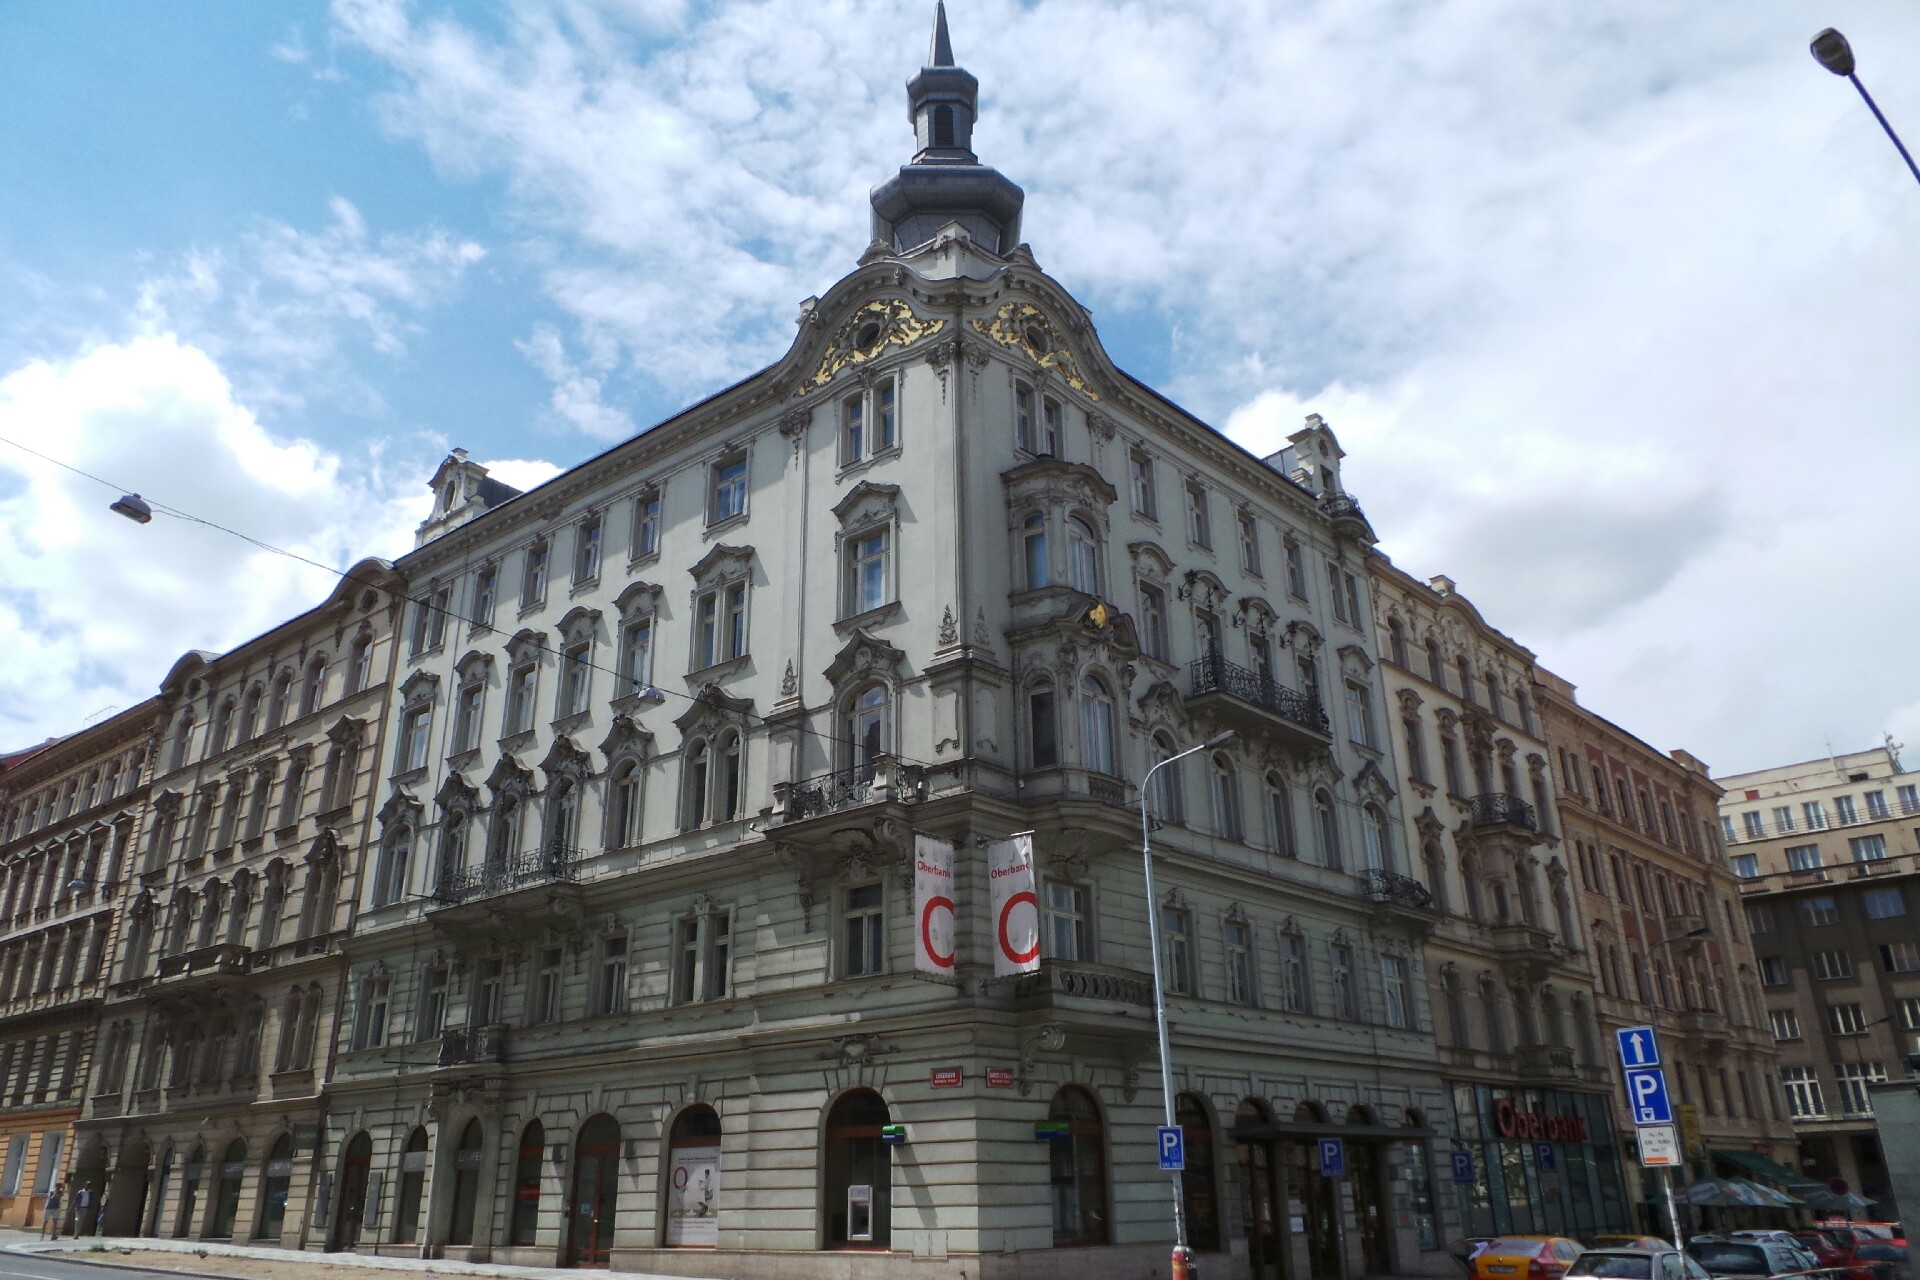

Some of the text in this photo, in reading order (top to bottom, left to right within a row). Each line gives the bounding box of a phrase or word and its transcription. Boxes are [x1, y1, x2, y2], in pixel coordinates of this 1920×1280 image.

[917, 861, 951, 878] Oberbank
[1634, 1074, 1658, 1107] P
[1162, 1132, 1178, 1157] P
[1324, 1143, 1338, 1165] P
[1539, 1145, 1550, 1160] P
[1454, 1155, 1468, 1175] P
